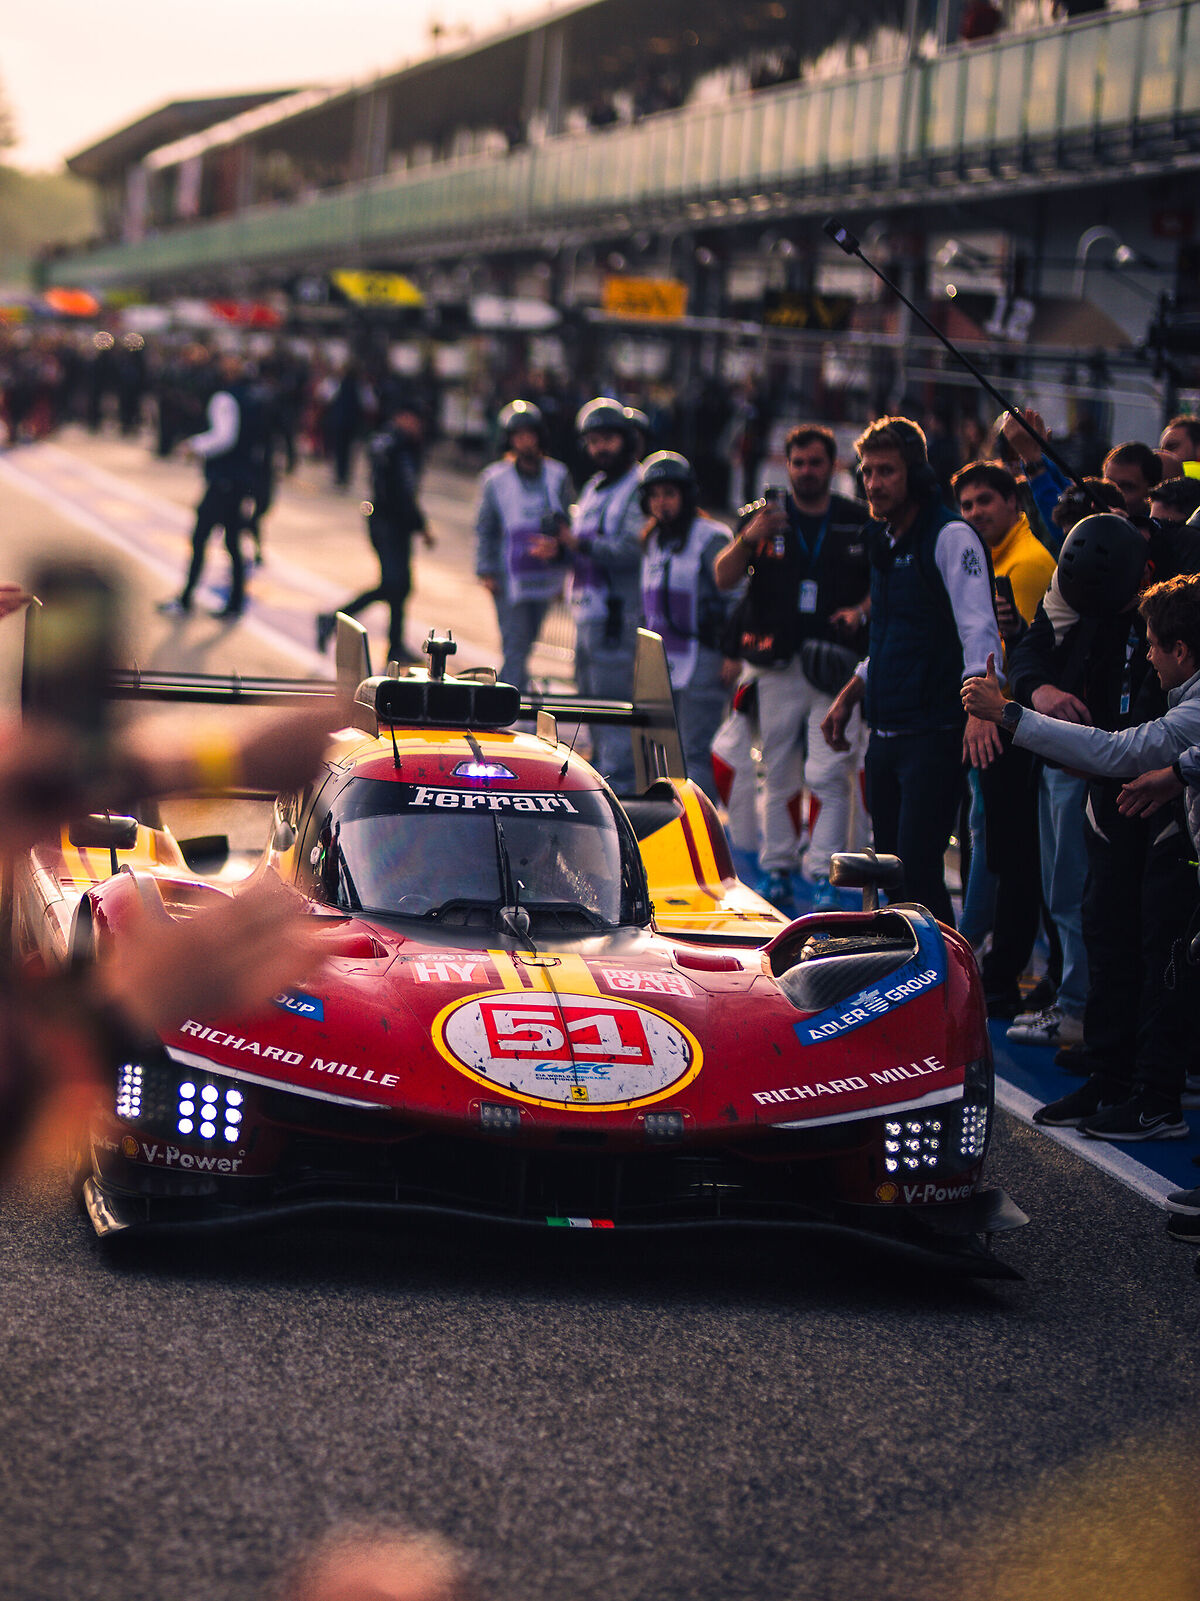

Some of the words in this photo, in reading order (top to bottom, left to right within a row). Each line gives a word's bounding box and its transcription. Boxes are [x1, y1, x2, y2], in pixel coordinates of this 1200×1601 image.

[408, 786, 579, 814] Ferrari
[414, 962, 477, 982] HY
[606, 970, 680, 983] HYPER
[612, 977, 687, 995] CAR
[808, 1008, 870, 1040] ADLER
[884, 969, 938, 1001] GROUP
[491, 1009, 643, 1057] 51
[179, 1019, 304, 1065] RICHARD
[310, 1057, 400, 1087] MILLE
[534, 1062, 614, 1075] WEC
[752, 1076, 869, 1105] RICHARD
[869, 1055, 945, 1085] MILLE
[142, 1143, 243, 1172] V-Power
[903, 1184, 975, 1203] V-Power
